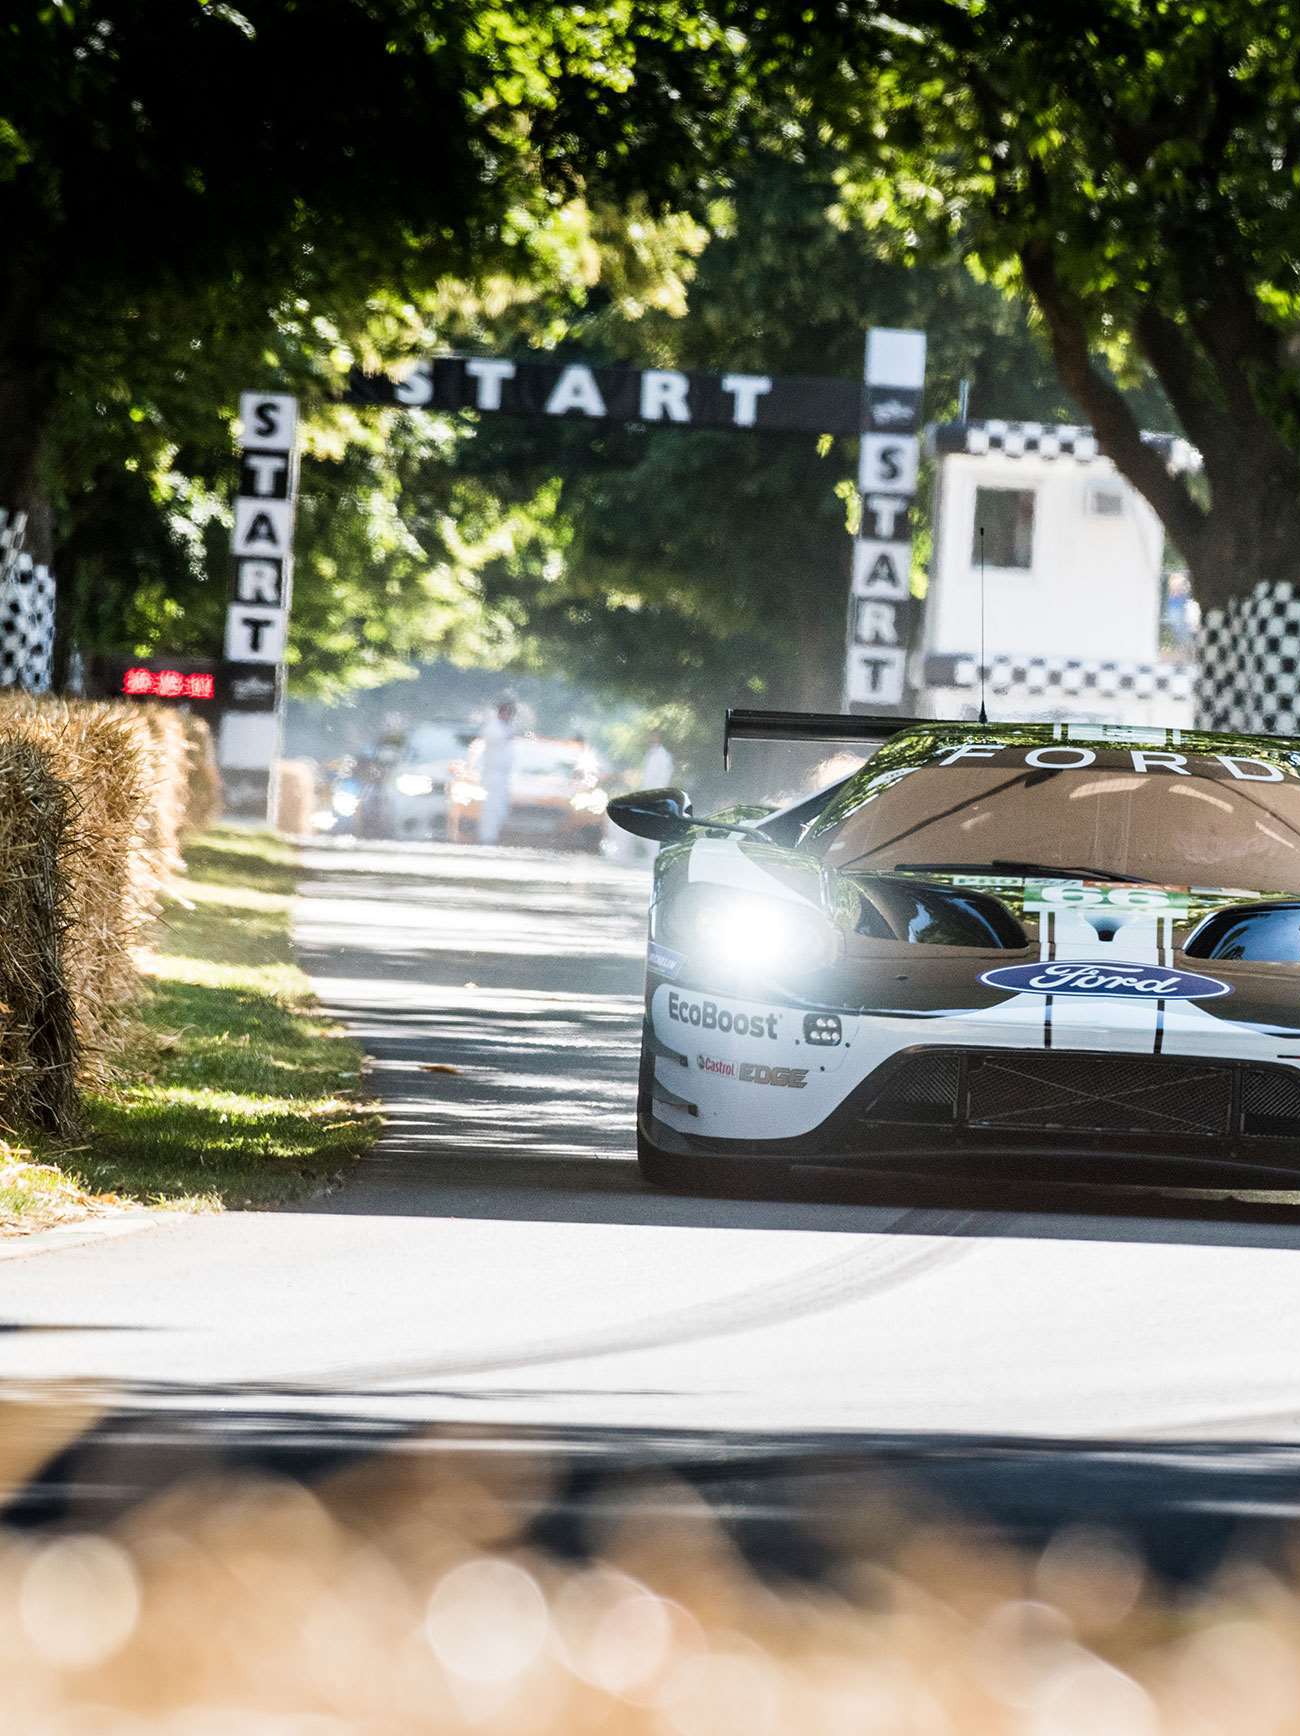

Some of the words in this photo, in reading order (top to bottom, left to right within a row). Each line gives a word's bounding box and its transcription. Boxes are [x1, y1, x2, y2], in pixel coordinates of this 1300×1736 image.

[395, 358, 773, 427] START
[237, 402, 286, 652] START
[857, 446, 908, 690] START
[939, 744, 1285, 783] FORD
[1041, 886, 1170, 907] 66
[1029, 965, 1181, 994] Ford
[669, 991, 778, 1040] EcoBoost
[704, 1057, 735, 1076] Castrol
[739, 1062, 809, 1088] EDGE
